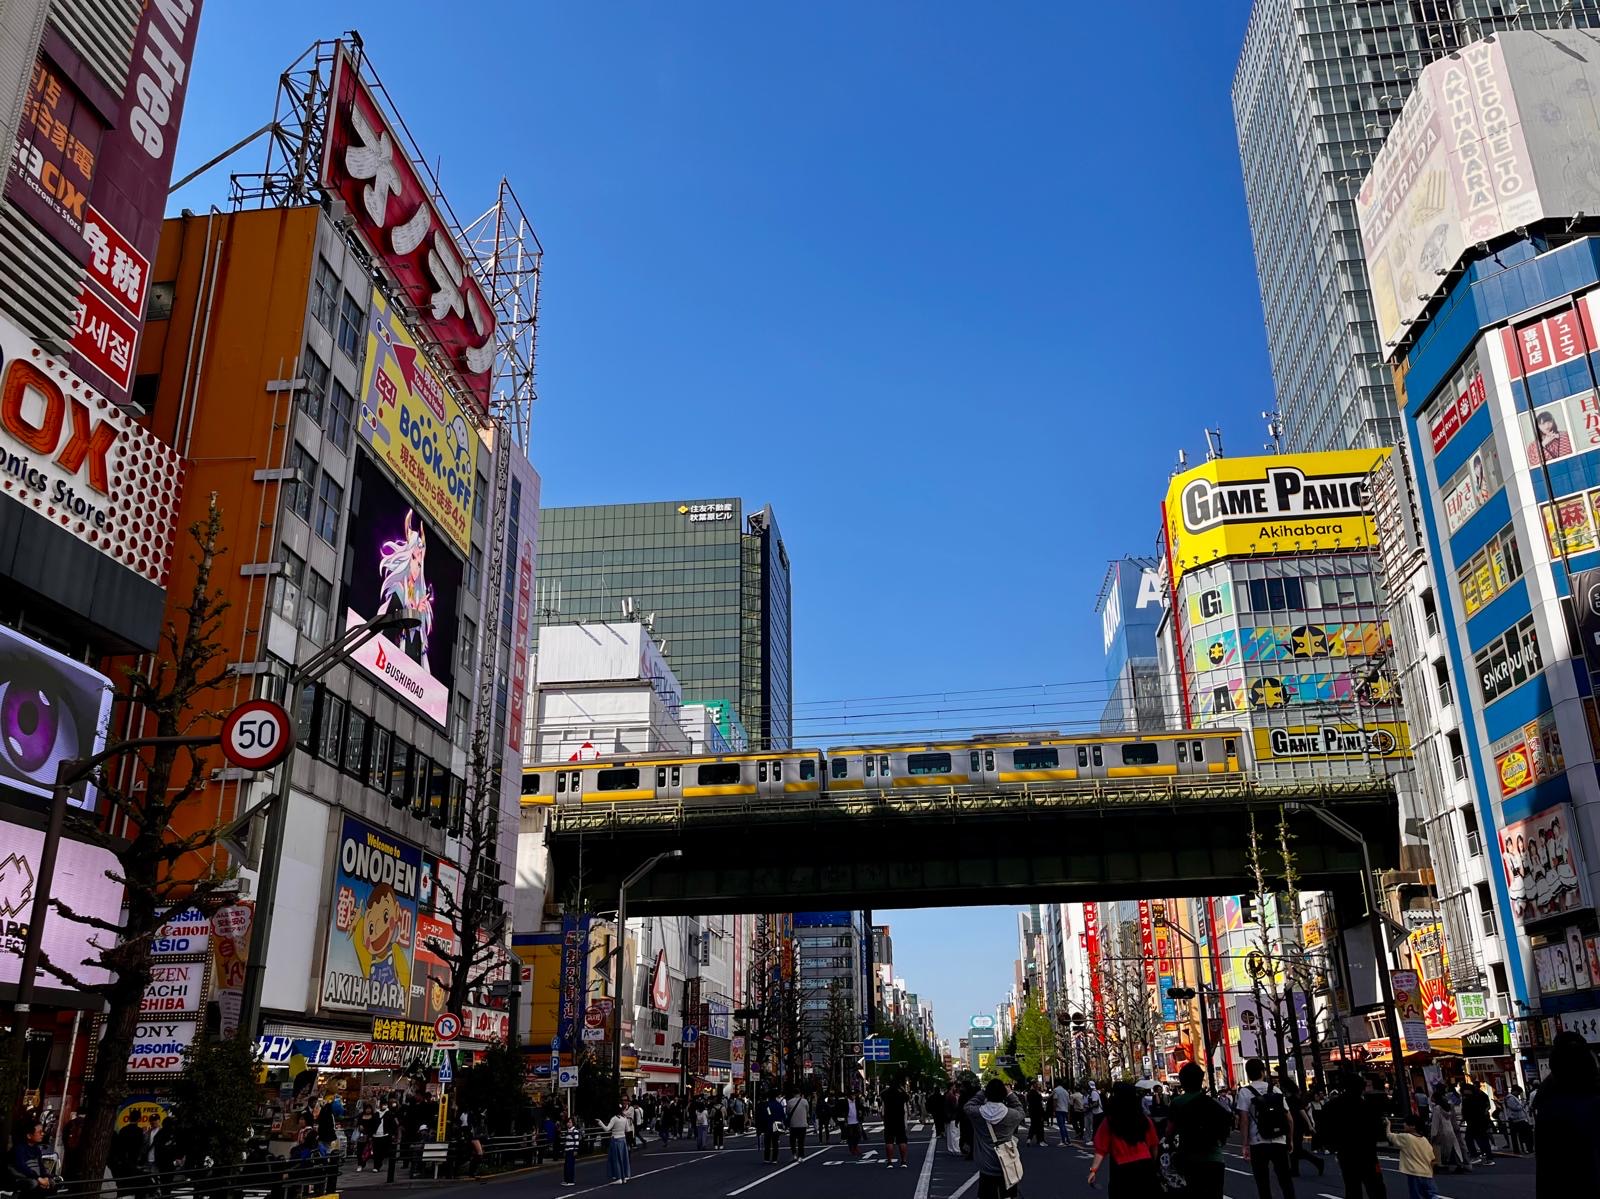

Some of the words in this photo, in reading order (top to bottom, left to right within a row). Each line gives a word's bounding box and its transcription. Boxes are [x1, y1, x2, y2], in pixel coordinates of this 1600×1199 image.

[130, 21, 186, 159] Free
[1466, 47, 1514, 156] WELCOME
[1495, 158, 1522, 197] TO
[1442, 66, 1493, 213] AKIHABARA
[1366, 127, 1438, 248] TAKARADA
[61, 210, 82, 233] Store
[345, 101, 497, 374] オノデン
[83, 222, 142, 304] 免税
[54, 479, 106, 528] Store
[1184, 482, 1269, 526] GAME
[1273, 471, 1371, 512] PANIC
[1258, 523, 1343, 540] Akihabara
[385, 662, 424, 700] BUSHIROAD
[238, 719, 276, 749] 50
[1272, 728, 1319, 754] GAME
[367, 832, 394, 856] Welcome
[394, 847, 401, 859] to
[342, 837, 417, 897] ONODEN
[160, 925, 209, 937] Canon
[325, 971, 406, 1010] AKIHABARA
[373, 1018, 406, 1041] 総合家電
[406, 1024, 418, 1041] TAX
[419, 1025, 436, 1043] FREE
[1480, 1031, 1499, 1044] mobile
[333, 1041, 370, 1064] オノデン
[370, 1044, 402, 1065] ONODEN
[552, 1057, 559, 1071] P
